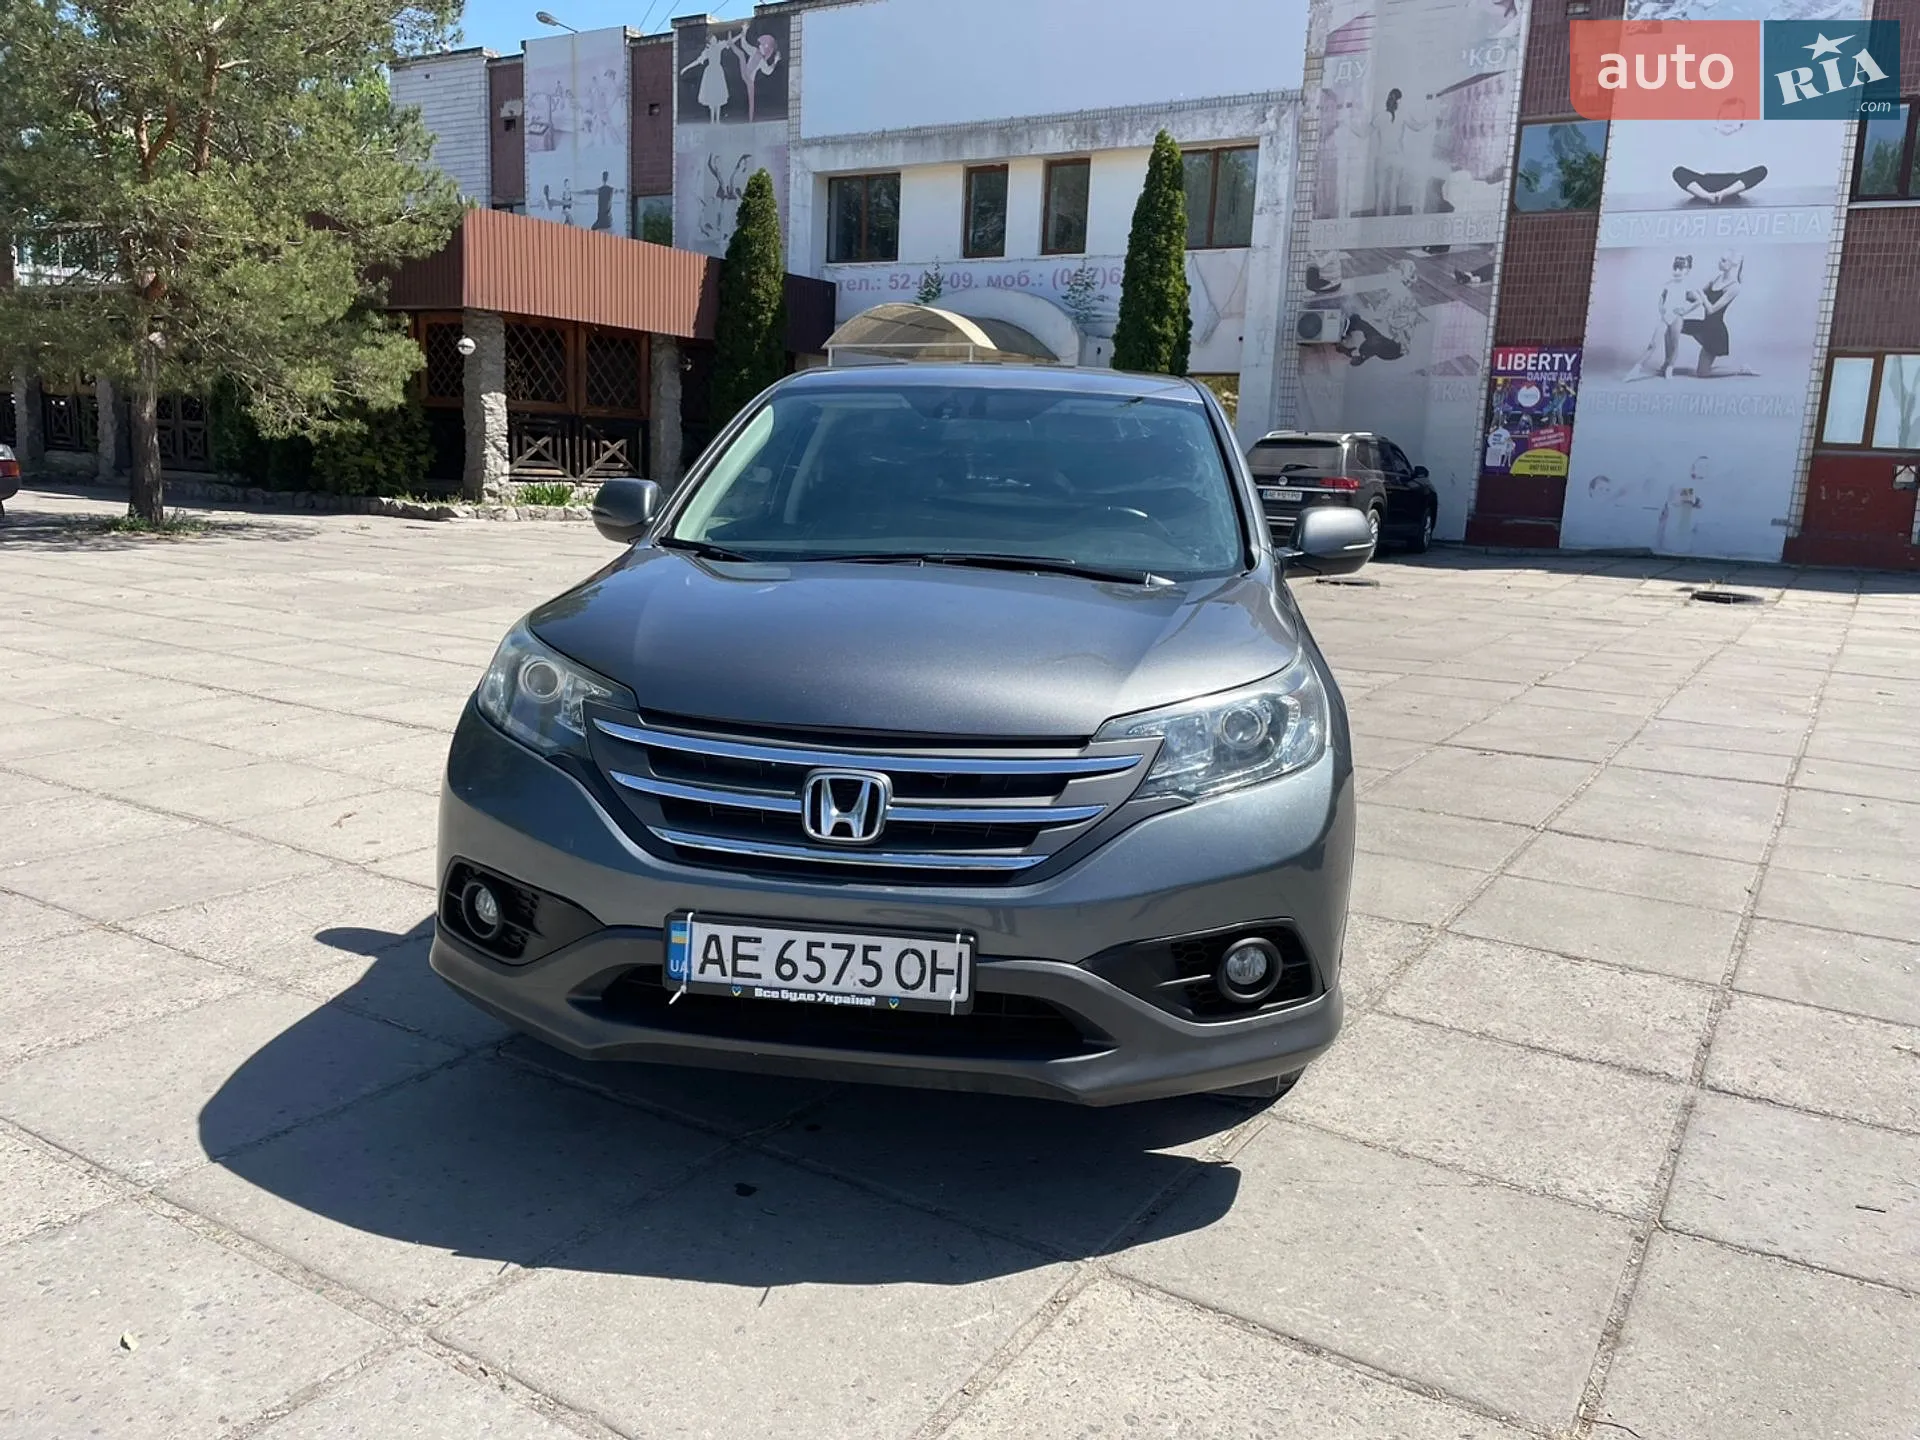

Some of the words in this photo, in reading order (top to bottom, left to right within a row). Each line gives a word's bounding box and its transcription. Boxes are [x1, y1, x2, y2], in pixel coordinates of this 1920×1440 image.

[1607, 216, 1706, 242] СТУДИЯ
[1716, 213, 1823, 236] БАЛЕТА
[986, 268, 1043, 289] моб.:
[1497, 352, 1577, 372] LIBERTY
[774, 940, 883, 988] 6575
[754, 987, 780, 999] Все
[781, 989, 816, 1002] буде
[817, 992, 876, 1007] Україна!
